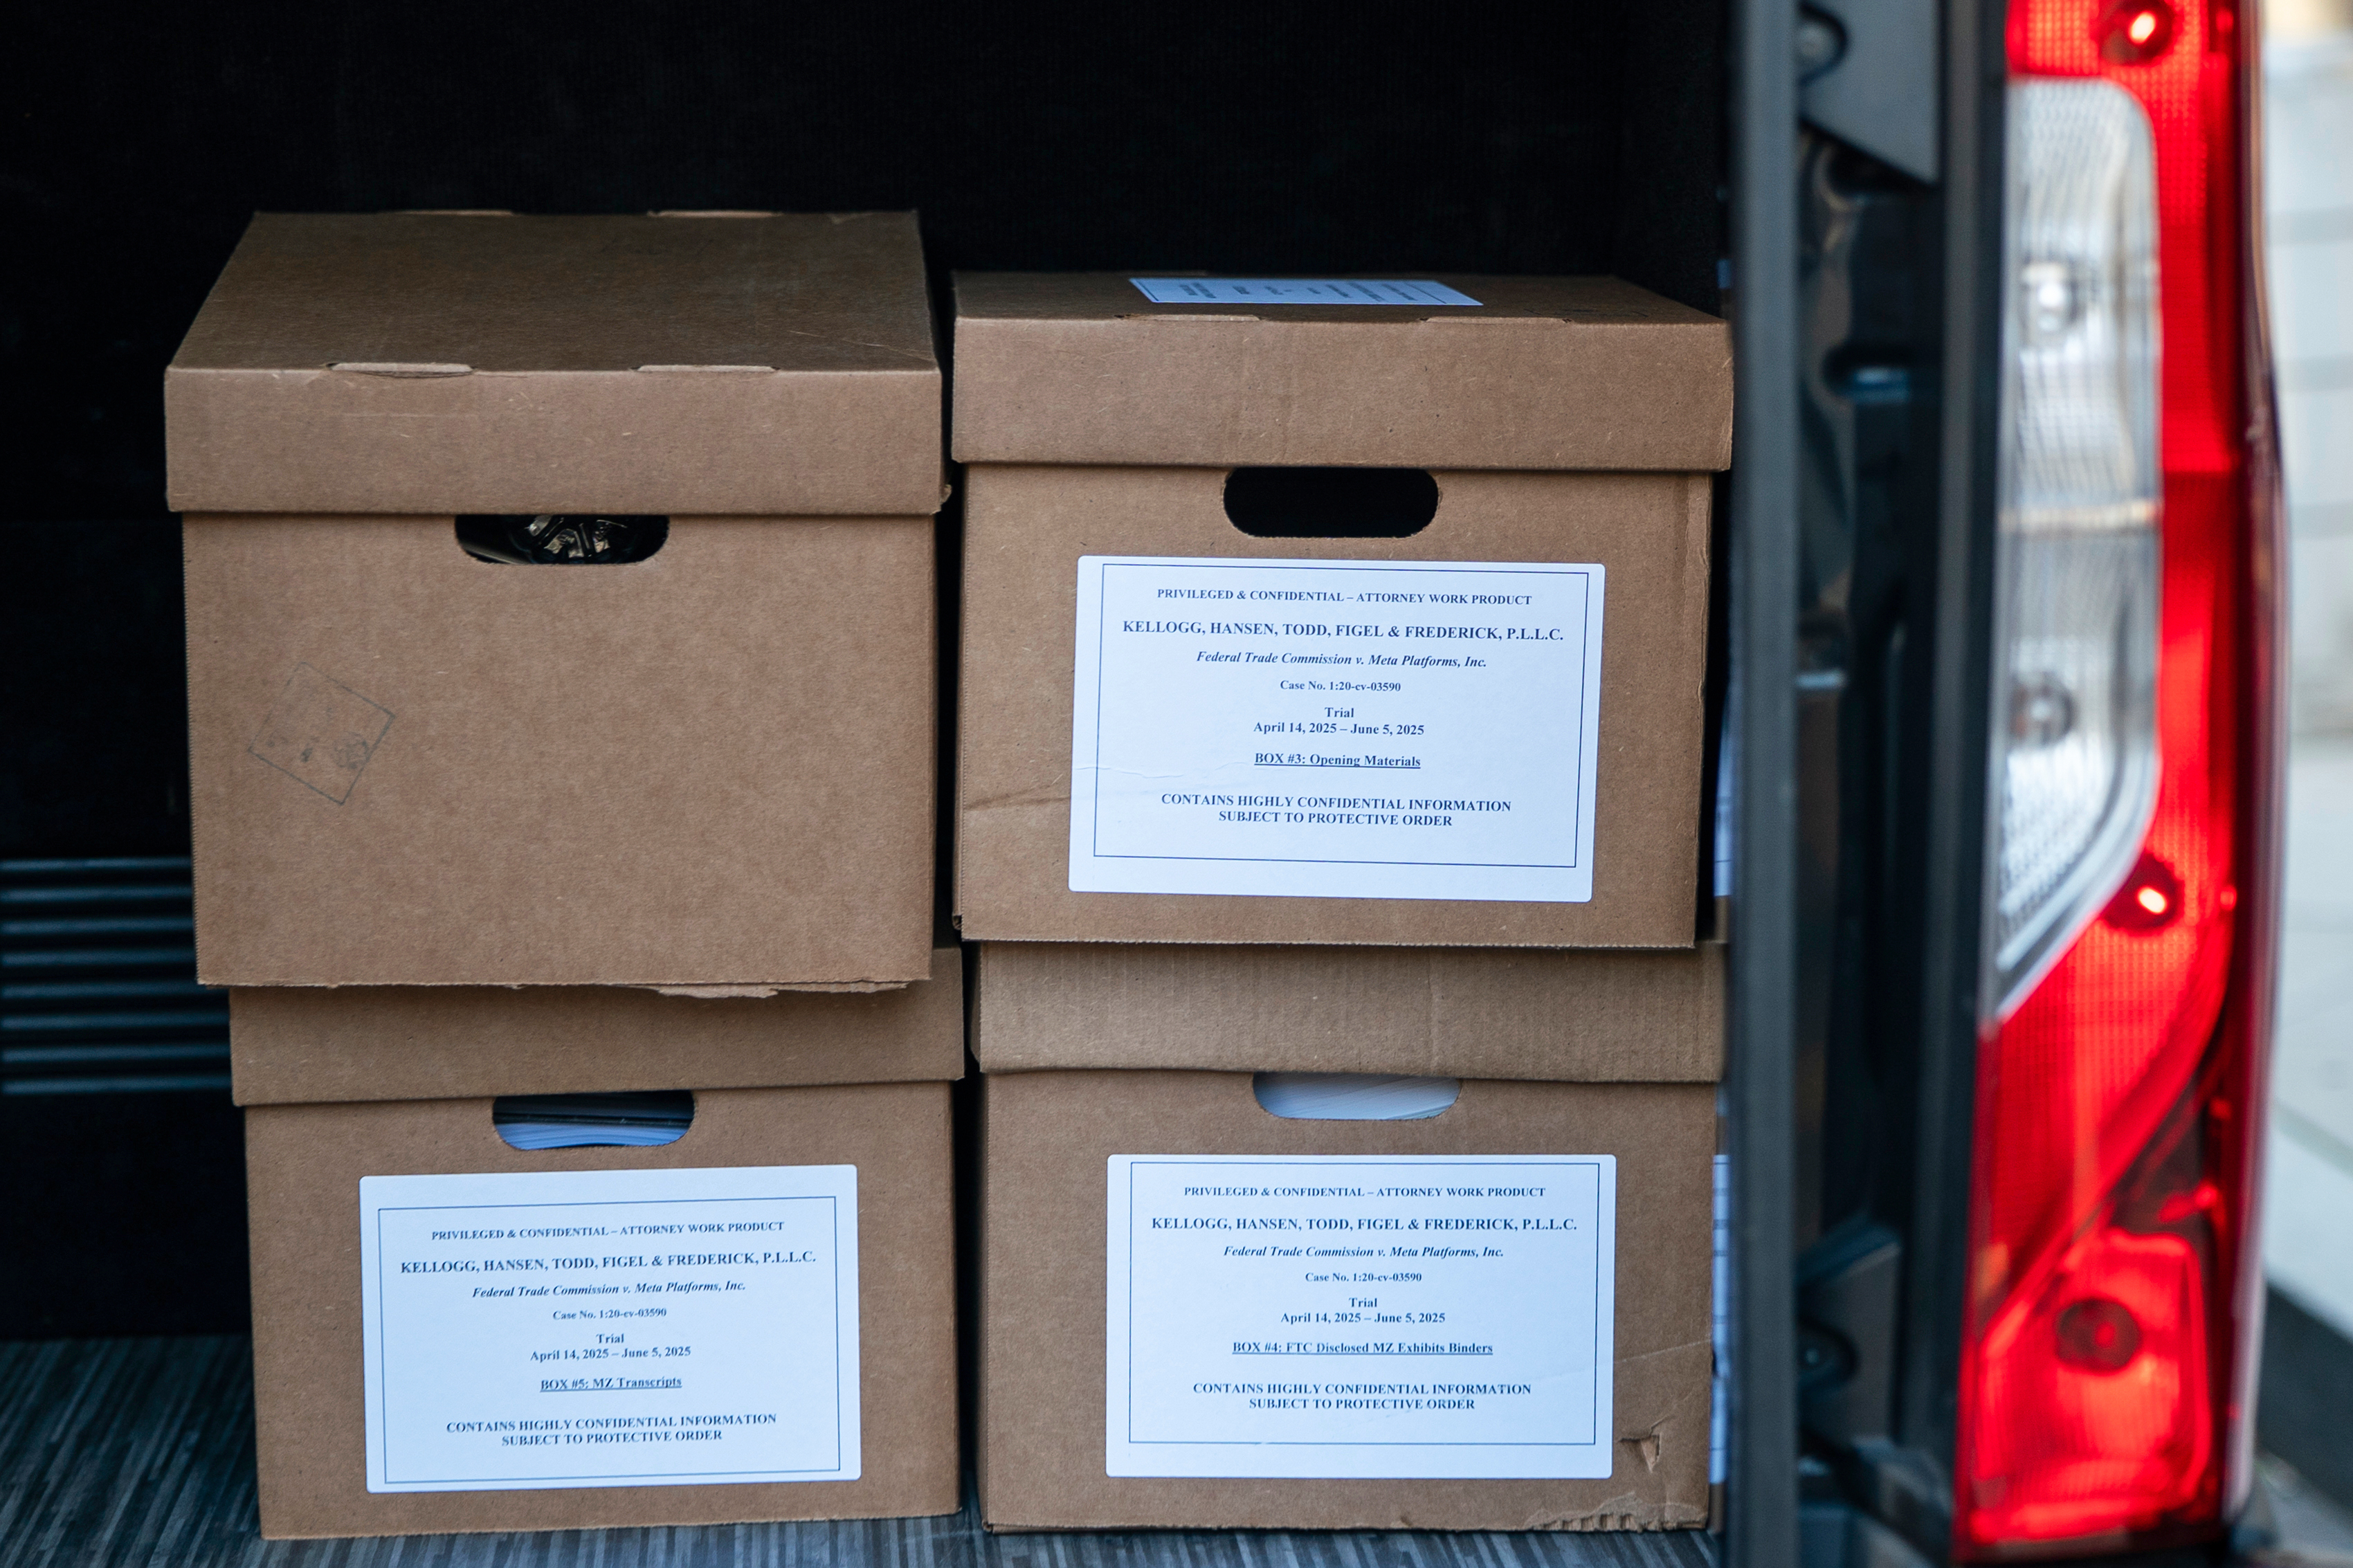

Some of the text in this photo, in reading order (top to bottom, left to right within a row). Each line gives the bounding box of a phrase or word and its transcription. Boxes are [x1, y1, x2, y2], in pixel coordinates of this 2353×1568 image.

[1157, 588, 1234, 600] PRIVILEGED
[1236, 590, 1246, 601] &
[1249, 590, 1345, 602] CONFIDENTIAL
[1356, 592, 1426, 603] ATTORNEY
[1428, 594, 1469, 605] WORK
[1471, 594, 1532, 605] PRODUCT
[1123, 620, 1563, 642] KELLOGG, HANSEN, TODD, FIGEL & FREDERICK, P.L.L.C.
[1196, 650, 1487, 669] Federal Trade Commission v. Meta Platforms, Inc.
[1280, 679, 1401, 693] Case No. 1:20-cv-03590
[1324, 706, 1354, 719] Trial
[1253, 721, 1285, 736] April
[1289, 721, 1306, 735] 14,
[1309, 722, 1337, 734] 2025
[1350, 722, 1379, 736] June
[1382, 723, 1393, 737] 5,
[1396, 723, 1425, 736] 2025
[1255, 752, 1421, 770] BOX #3: Opening Materials
[1161, 793, 1511, 812] CONTAINS HIGHLY CONFIDENTIAL INFORMATION
[1219, 810, 1453, 827] SUBJECT TO PROTECTIVE ORDER
[1184, 1187, 1258, 1197] PRIVILEGED
[1260, 1187, 1270, 1197] &
[1273, 1187, 1365, 1197] CONFIDENTIAL
[1377, 1187, 1443, 1197] ATTORNEY
[1446, 1187, 1484, 1198] WORK
[1487, 1187, 1546, 1198] PRODUCT
[431, 1229, 505, 1241] PRIVILEGED
[507, 1229, 516, 1239] &
[519, 1226, 609, 1239] CONFIDENTIAL
[619, 1224, 685, 1236] ATTORNEY
[687, 1223, 725, 1234] WORK
[728, 1221, 785, 1233] PRODUCT
[1152, 1217, 1577, 1232] KELLOGG, HANSEN, TODD, FIGEL & FREDERICK, P.L.L.C.
[1224, 1246, 1504, 1260] Federal Trade Commission v. Meta Platforms, Inc.
[401, 1250, 816, 1275] KELLOGG, HANSEN, TODD, FIGEL & FREDERICK, P.L.L.C.
[1305, 1272, 1422, 1283] Case No. 1:20-cv-03590
[472, 1279, 745, 1299] Federal Trade Commission v. Meta Platforms, Inc.
[1348, 1297, 1378, 1309] Trial
[552, 1307, 667, 1321] Case No. 1:20-cv-03590
[1280, 1311, 1311, 1326] April
[1316, 1311, 1332, 1324] 14,
[1334, 1311, 1361, 1323] 2025
[1374, 1312, 1402, 1323] June
[1405, 1312, 1415, 1324] 5,
[1419, 1311, 1446, 1323] 2025
[595, 1332, 624, 1344] Trial
[530, 1349, 560, 1364] April
[564, 1348, 580, 1362] 14,
[582, 1347, 609, 1360] 2025
[621, 1347, 649, 1358] June
[651, 1346, 662, 1359] 5,
[664, 1345, 691, 1358] 2025
[1233, 1342, 1493, 1356] BOX #4: FTC Disclosed MZ Exhibits Binders
[540, 1376, 682, 1394] BOX #5: MZ Transcripts
[1193, 1383, 1531, 1395] CONTAINS HIGHLY CONFIDENTIAL INFORMATION
[1249, 1398, 1475, 1410] SUBJECT TO PROTECTIVE ORDER
[446, 1413, 776, 1433] CONTAINS HIGHLY CONFIDENTIAL INFORMATION
[502, 1429, 723, 1446] SUBJECT TO PROTECTIVE ORDER
